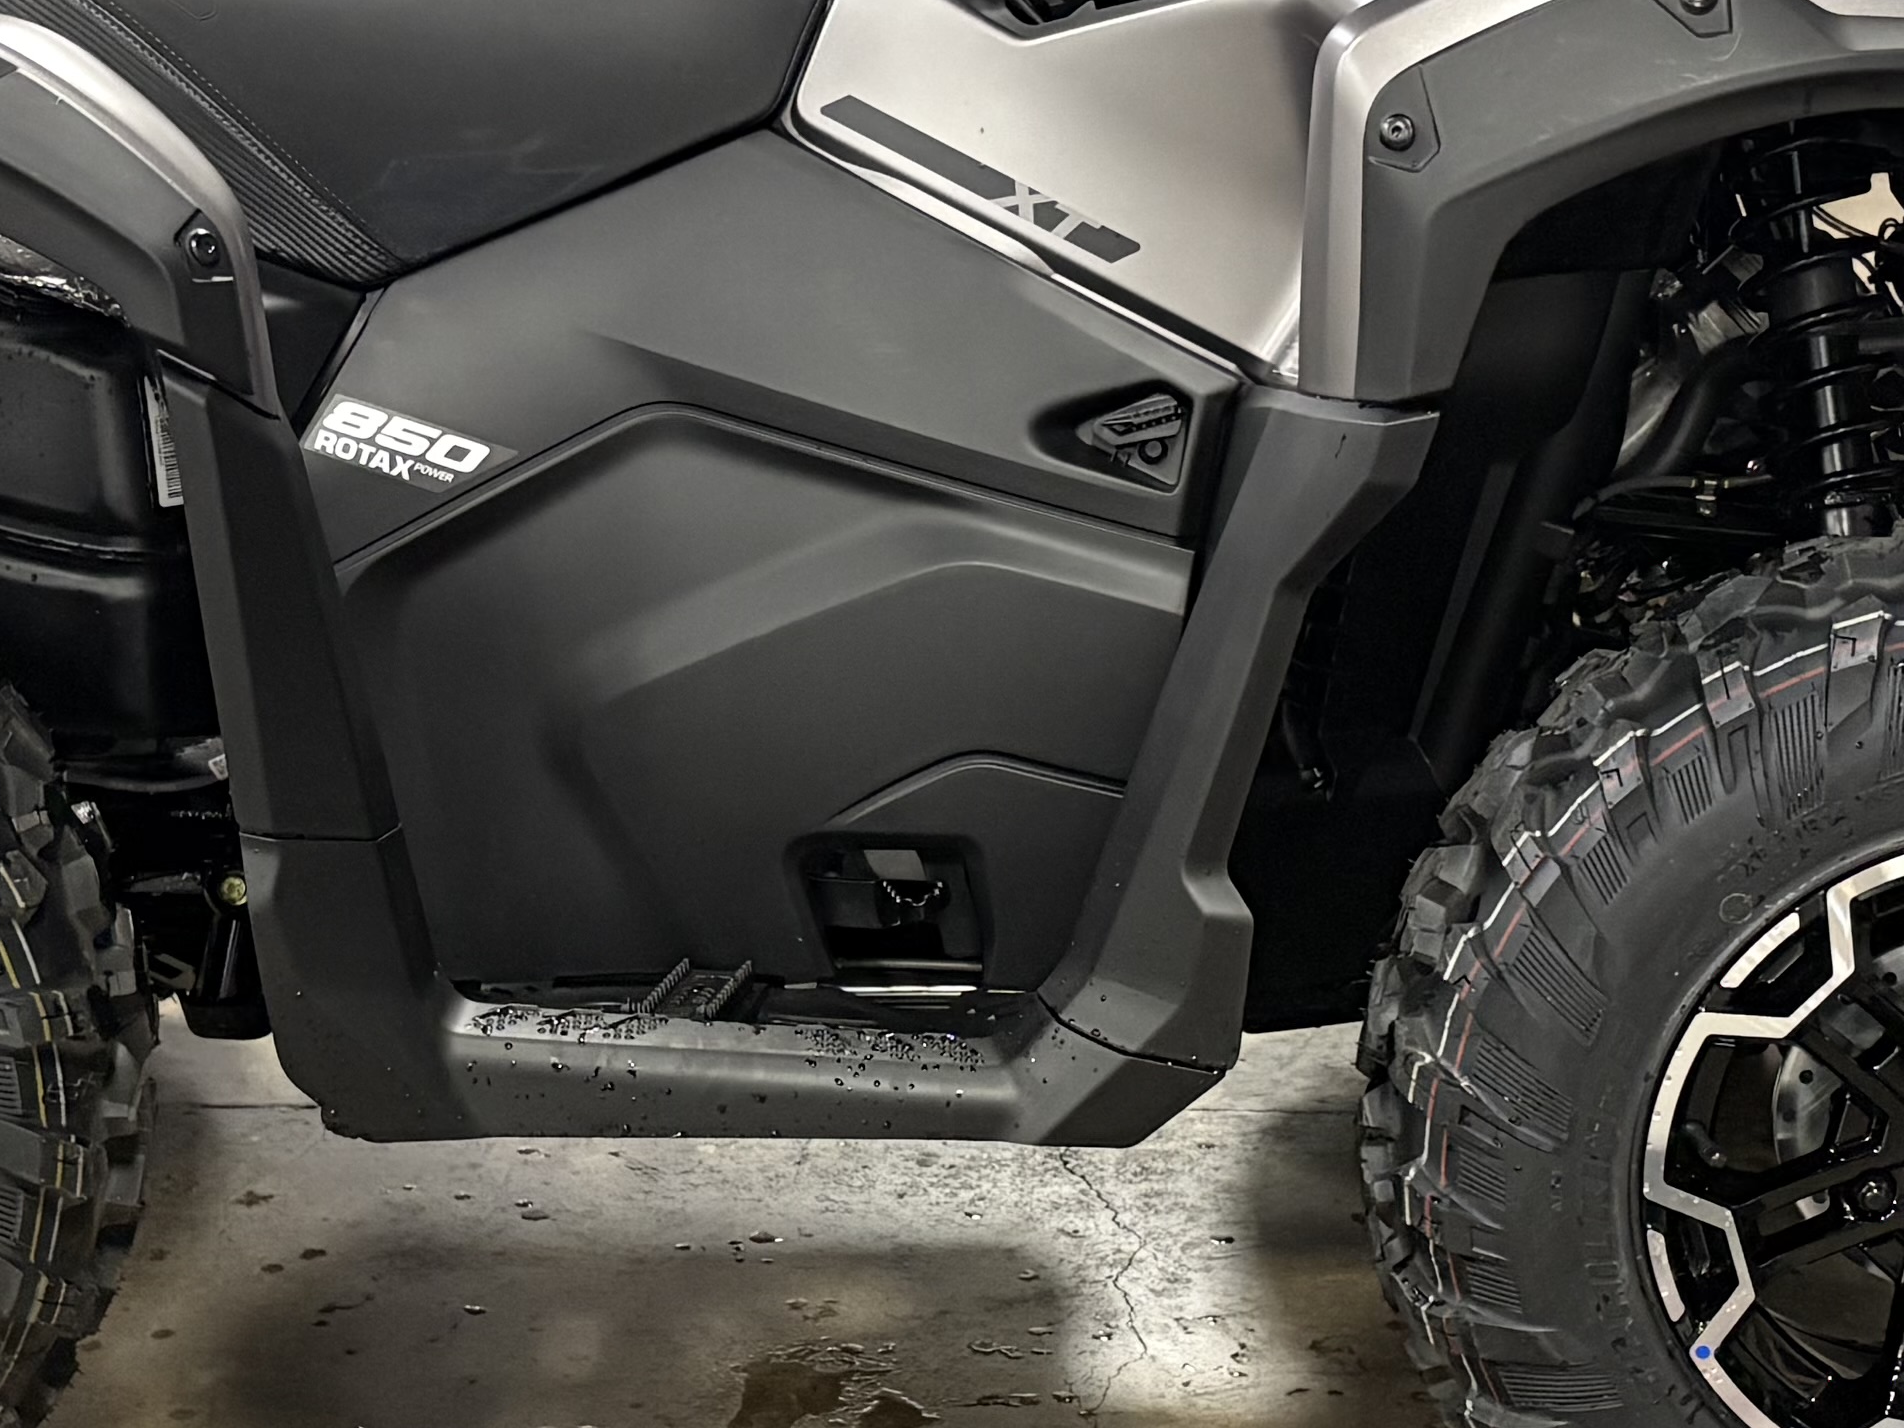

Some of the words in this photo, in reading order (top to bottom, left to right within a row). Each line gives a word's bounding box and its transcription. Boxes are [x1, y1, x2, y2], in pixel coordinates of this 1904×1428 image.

[988, 181, 1102, 240] XT
[313, 428, 416, 482] ROTAX
[413, 461, 455, 484] POWER
[322, 400, 491, 474] 850
